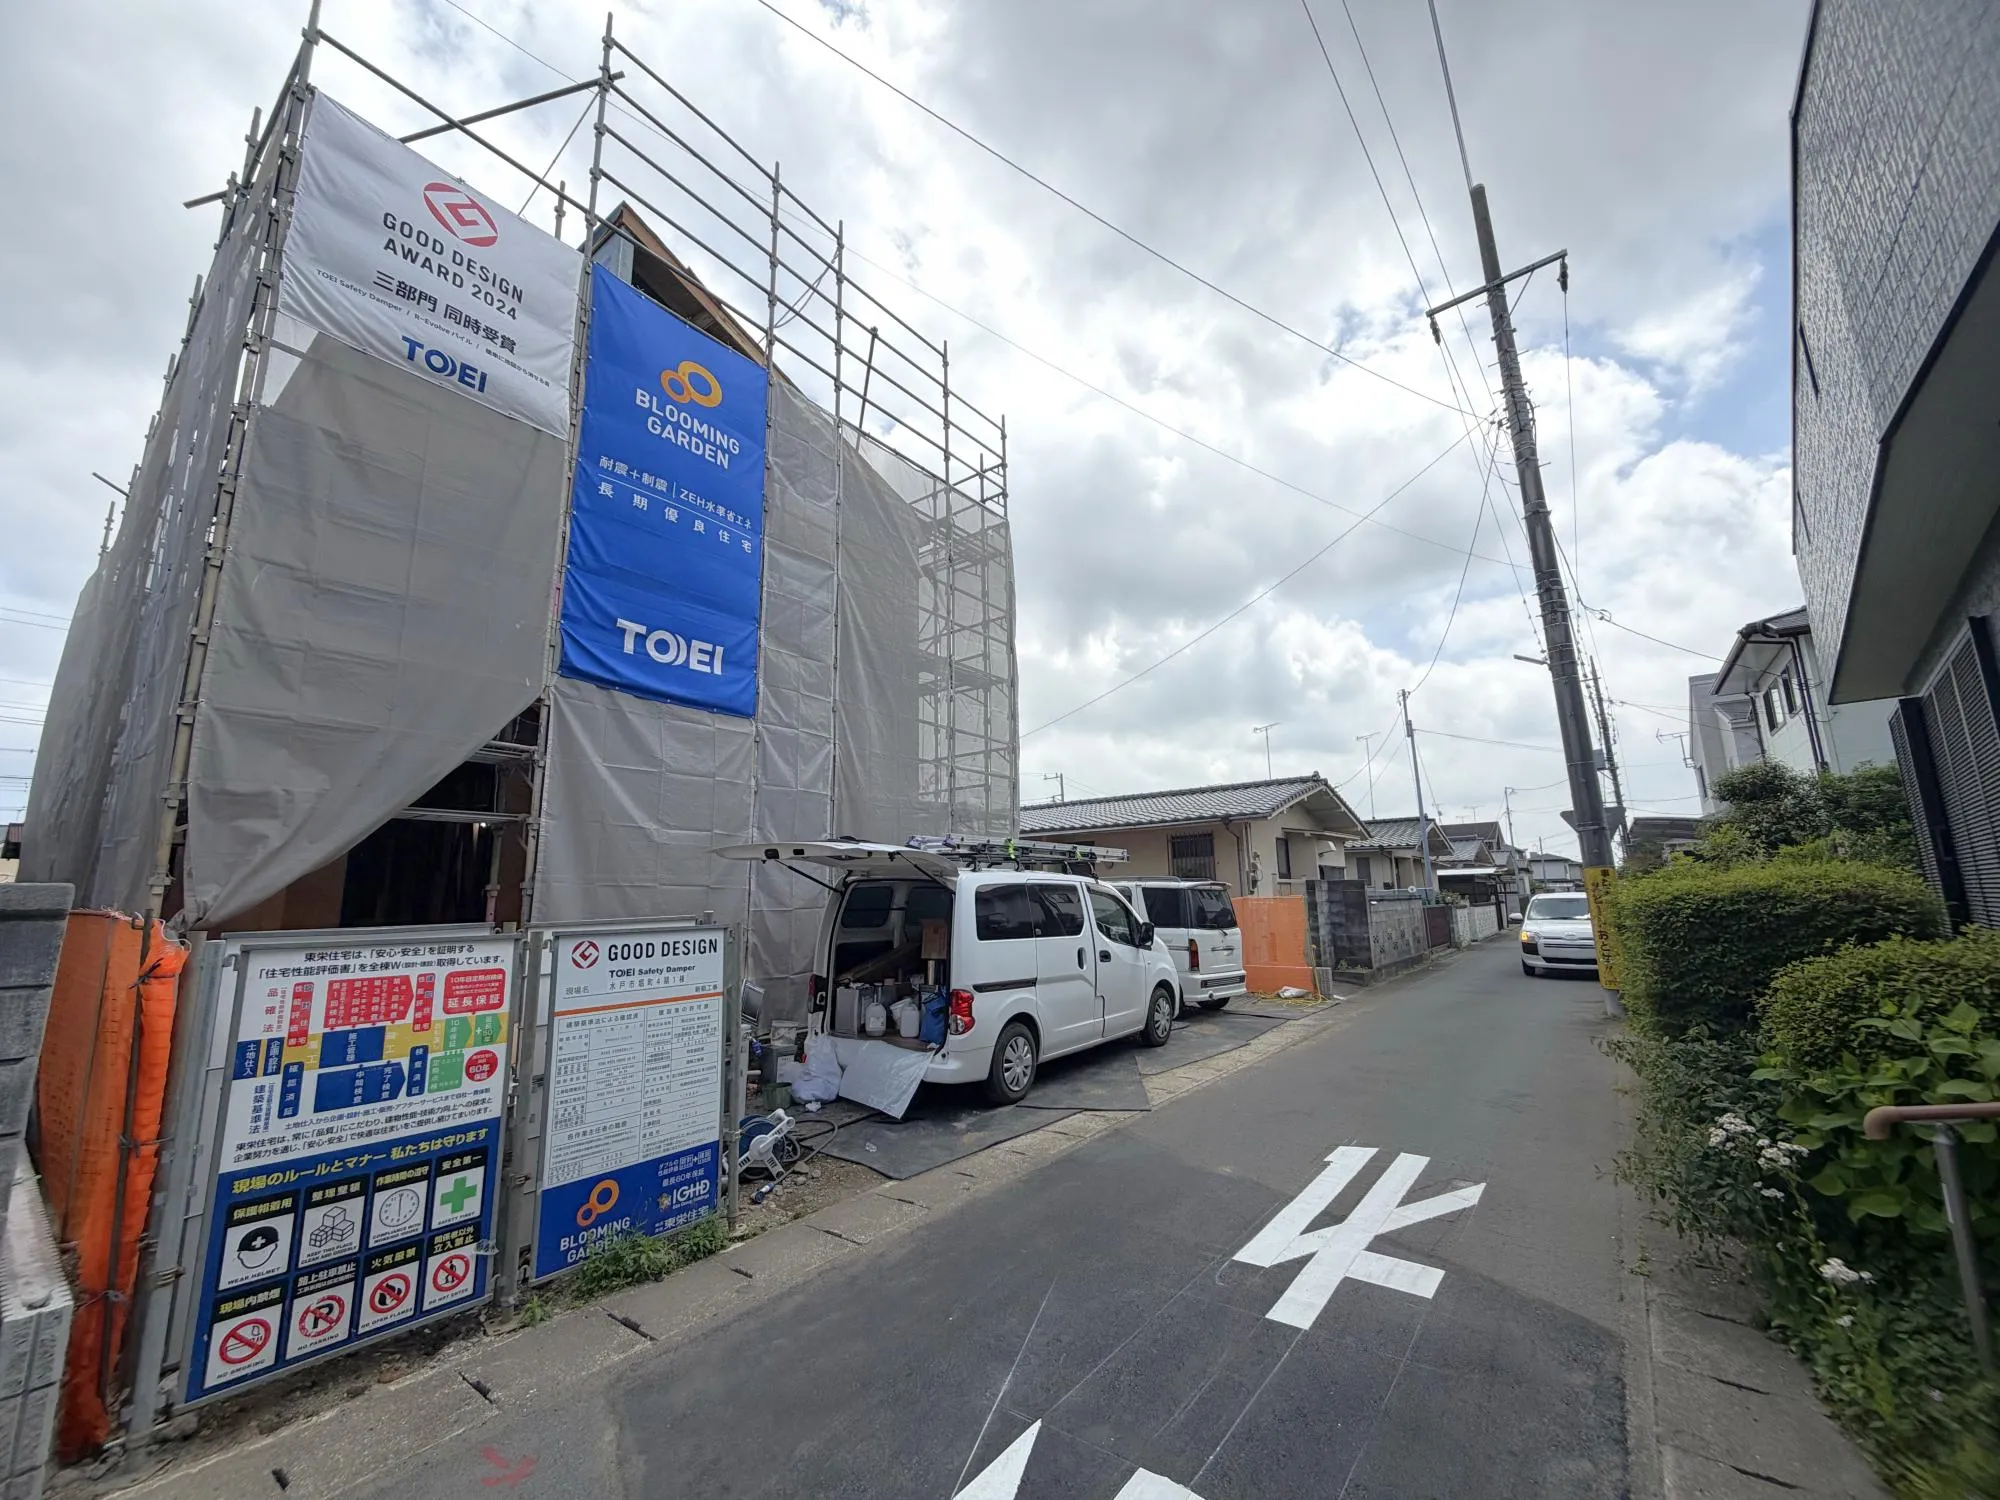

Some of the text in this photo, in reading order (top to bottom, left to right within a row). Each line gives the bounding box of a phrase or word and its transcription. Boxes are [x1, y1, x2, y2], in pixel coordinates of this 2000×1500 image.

[383, 211, 523, 304] GOOD DESIGN
[383, 237, 518, 321] AWARD 2024
[373, 270, 517, 356] 三部門 同時受賞
[401, 336, 487, 393] TOEI
[635, 388, 740, 456] BLOOMING
[647, 416, 730, 470] GARDEN
[598, 481, 753, 553] 長期優良住宅
[616, 617, 725, 676] TOEI
[607, 937, 717, 962] GOOD DESIGN
[607, 963, 696, 979] TOEI Safety Damper
[565, 984, 590, 996] 現場名
[231, 1127, 488, 1195] 現場のルールとマナー 私たちは守ります
[432, 1232, 474, 1254] 立入禁止
[559, 1215, 630, 1252] BLOOMING
